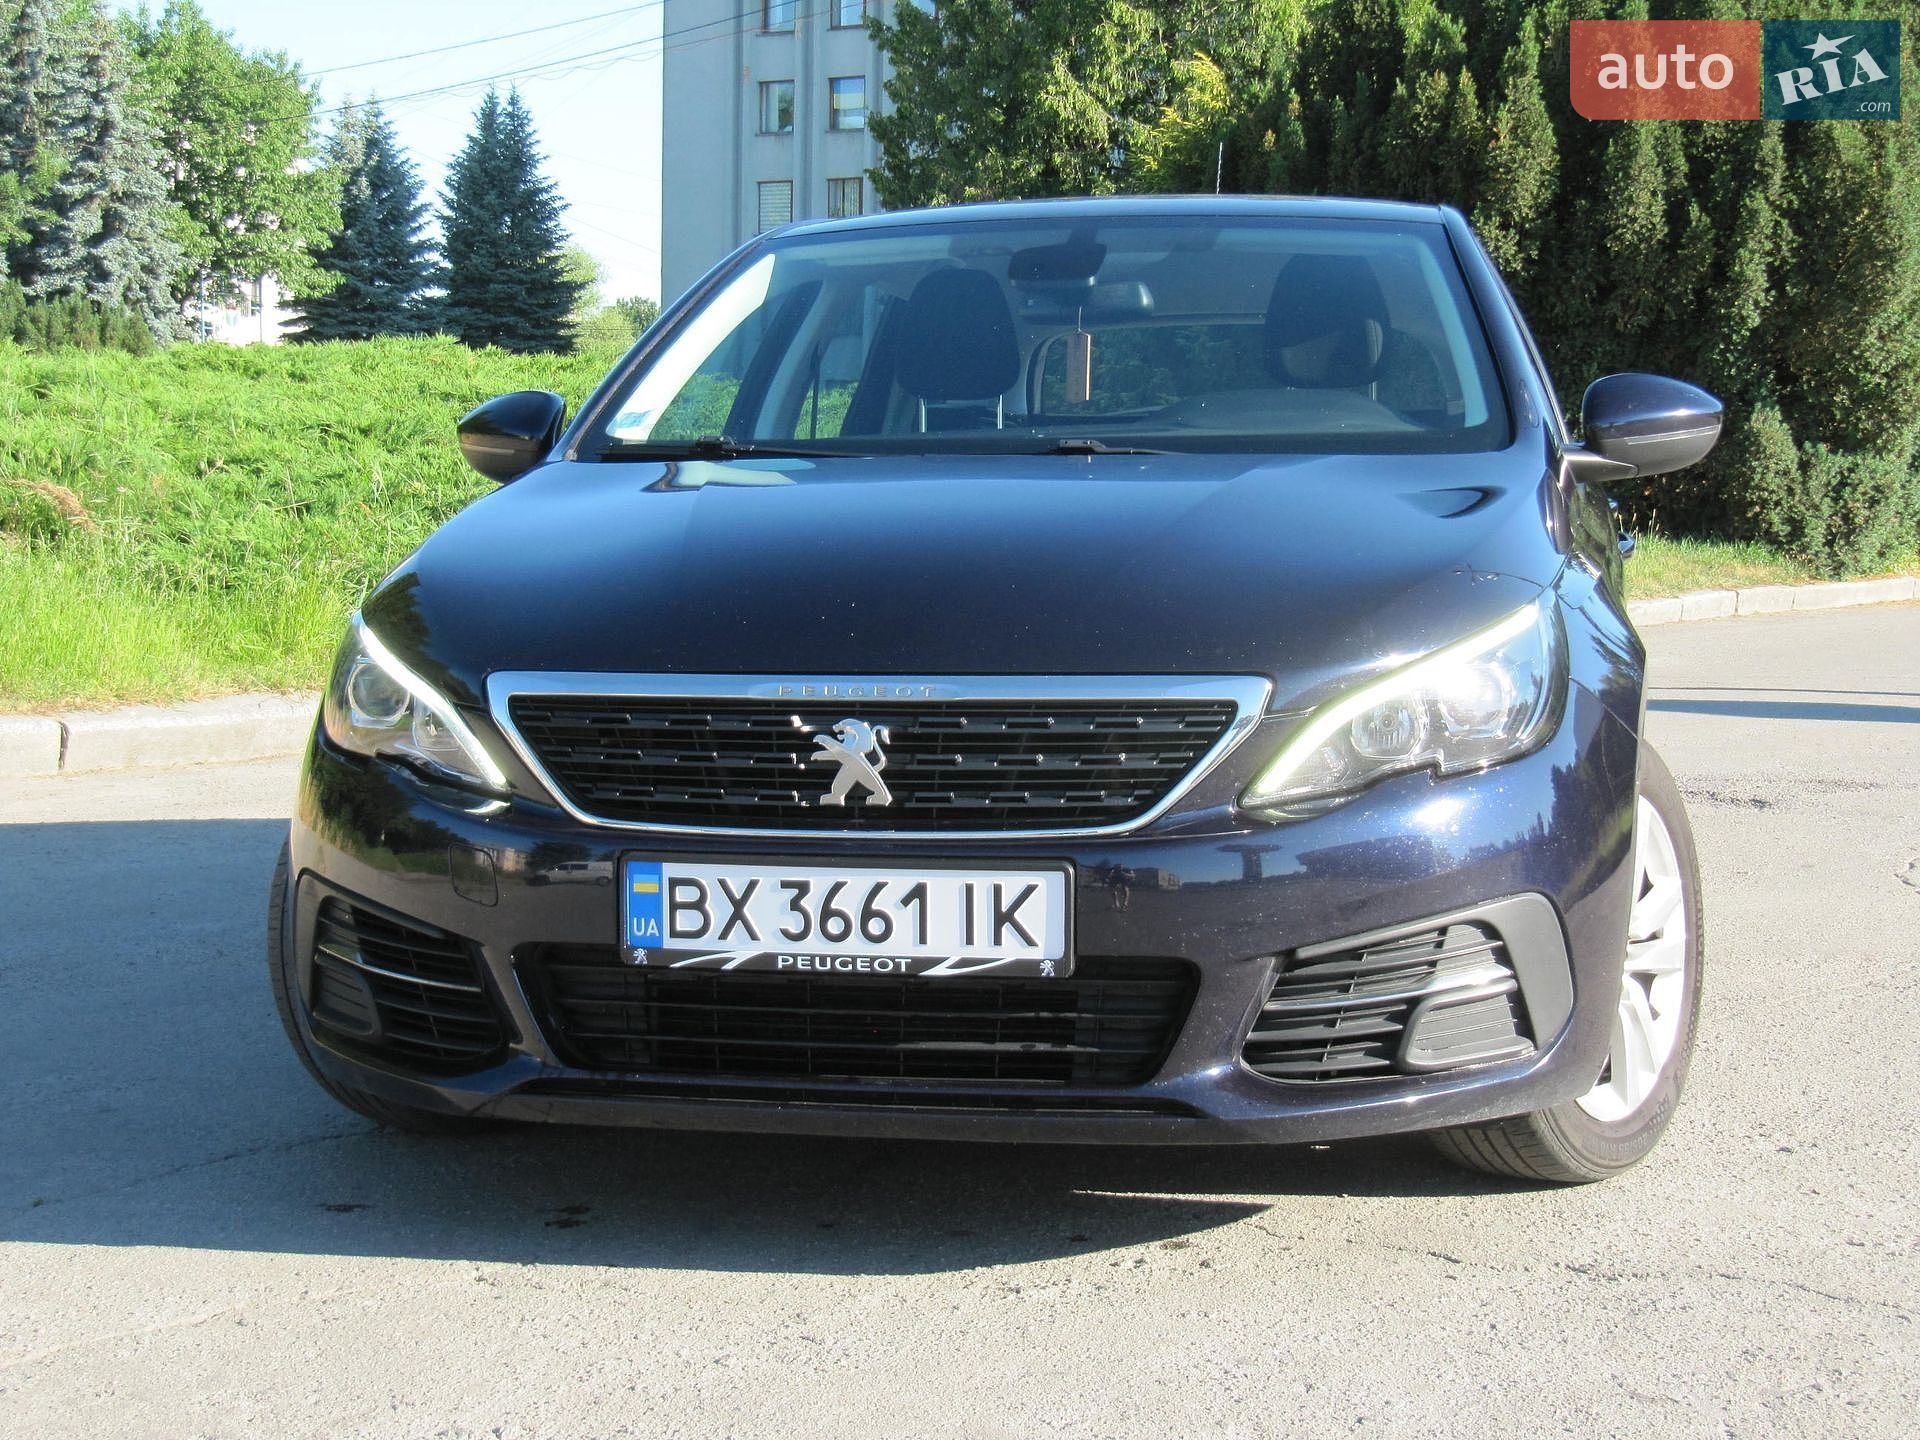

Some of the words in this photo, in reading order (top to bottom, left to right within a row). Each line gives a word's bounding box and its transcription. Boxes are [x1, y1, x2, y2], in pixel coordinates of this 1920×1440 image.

[777, 684, 936, 698] PEUGEOT
[668, 876, 761, 942] BX
[779, 880, 928, 945] 3661
[964, 883, 1039, 947] IK
[633, 917, 660, 938] UA
[777, 955, 912, 973] PEUGEOT
